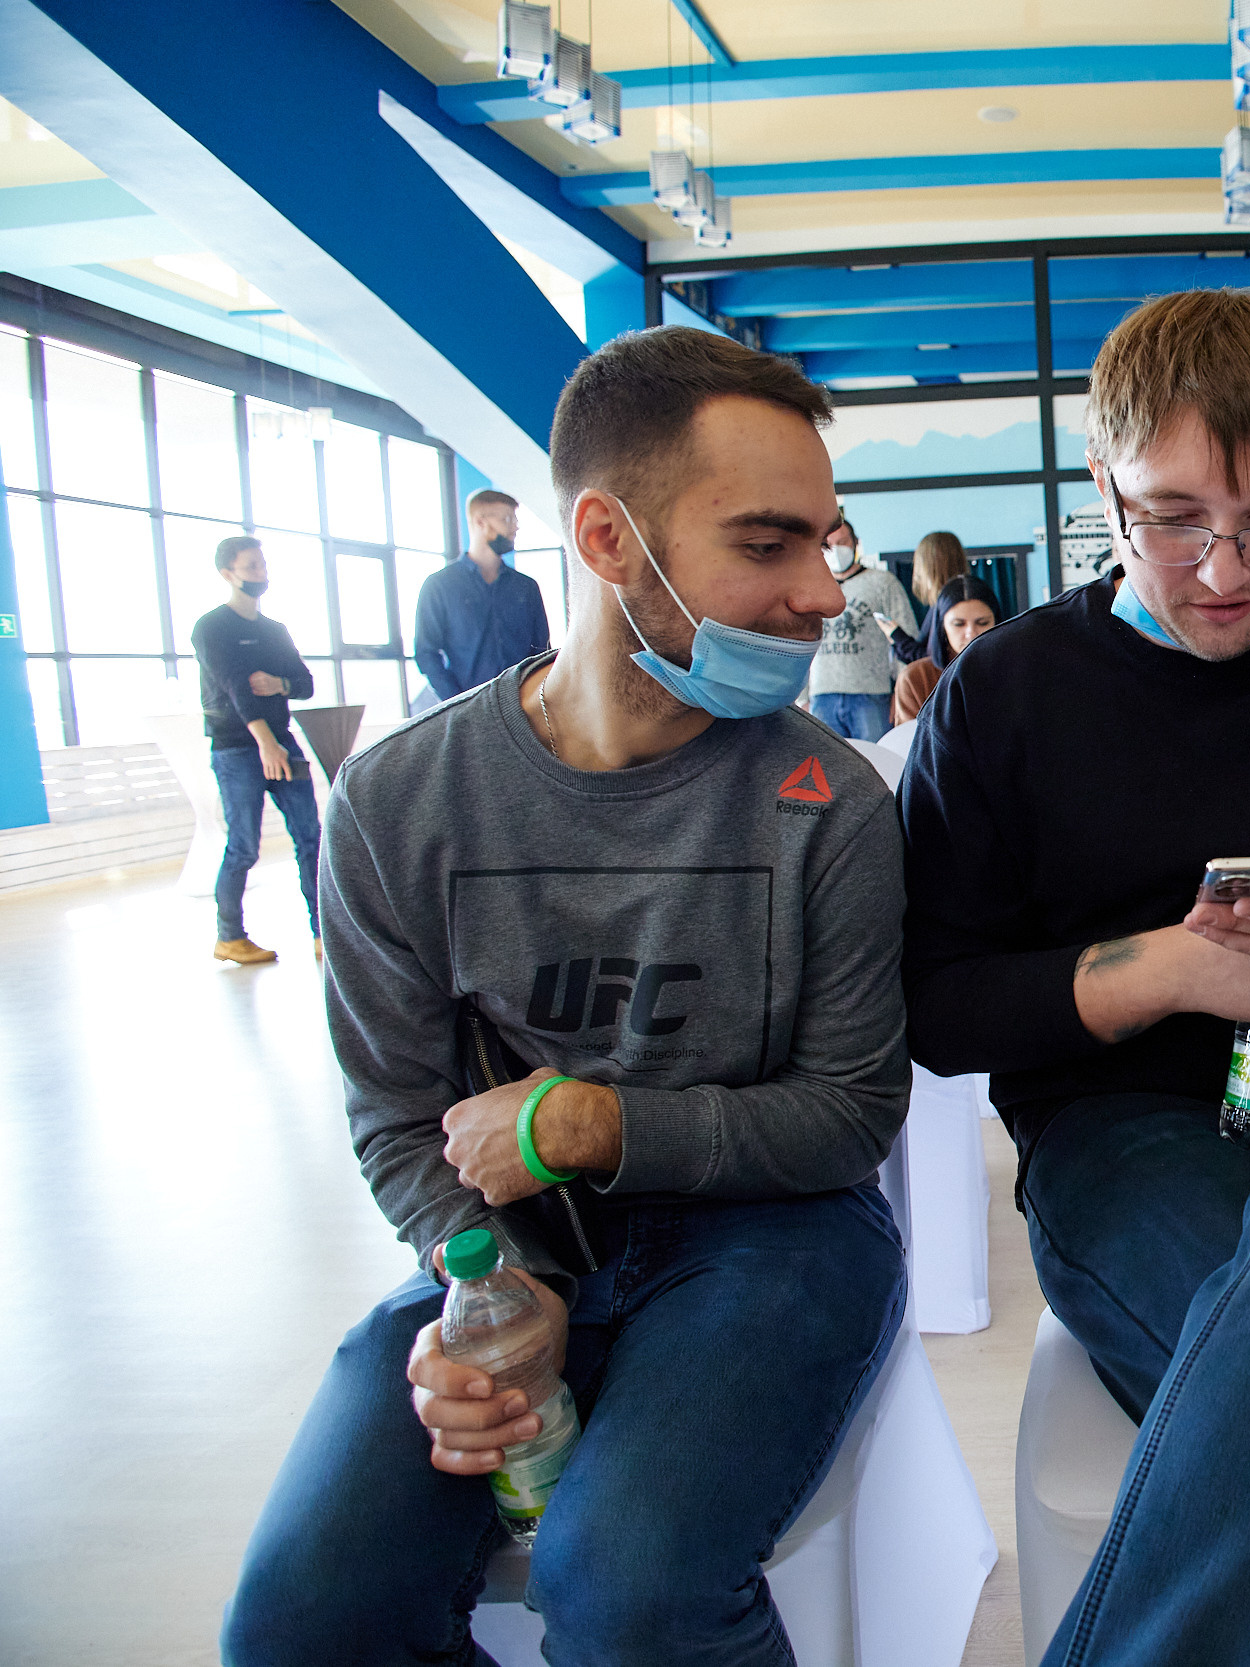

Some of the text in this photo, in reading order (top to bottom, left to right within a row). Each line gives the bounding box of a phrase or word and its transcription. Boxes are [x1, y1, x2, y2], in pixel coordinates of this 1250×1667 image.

[776, 800, 829, 819] Reebok
[525, 957, 702, 1036] UFC
[642, 1046, 707, 1063] Discipline.
